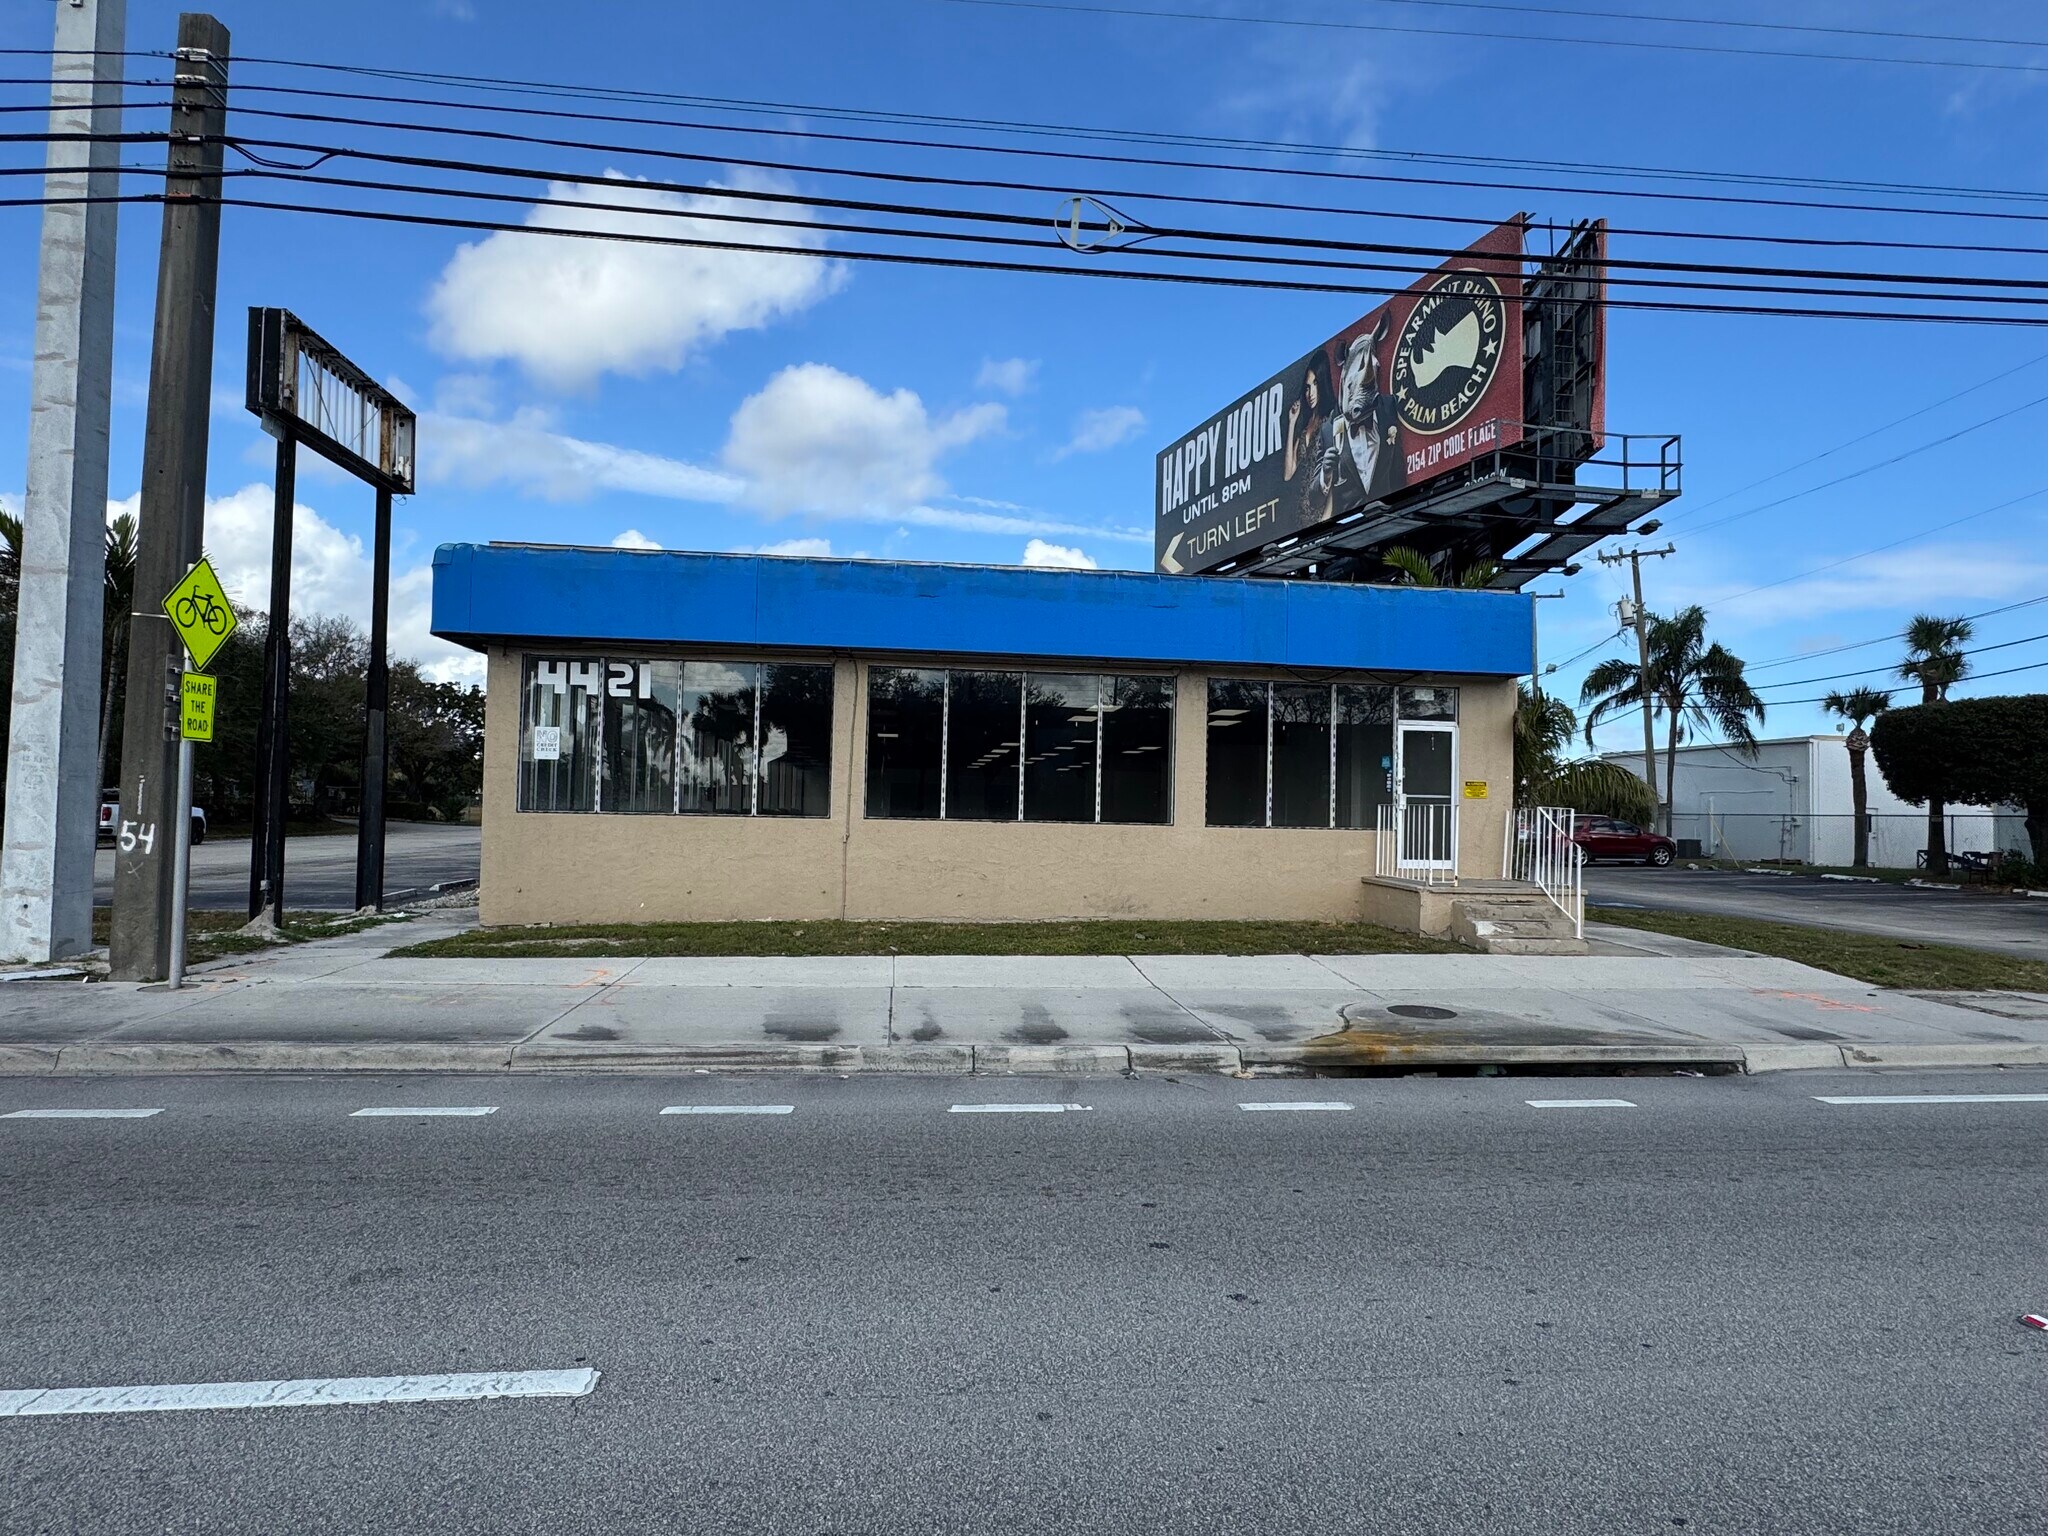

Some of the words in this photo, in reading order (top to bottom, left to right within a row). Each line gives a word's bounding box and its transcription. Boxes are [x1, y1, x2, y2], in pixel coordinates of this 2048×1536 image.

[1396, 281, 1460, 381] SPEARMINT
[1462, 280, 1497, 333] RHINO
[1404, 398, 1437, 423] PALM
[1440, 364, 1487, 420] BEACH
[1162, 421, 1222, 516] HAPPY
[1224, 382, 1283, 479] HOUR
[1406, 448, 1426, 475] 2154
[1427, 442, 1442, 466] ZIP
[1443, 430, 1466, 459] CODE
[1183, 492, 1219, 524] UNTIL
[1221, 475, 1251, 504] 8PM
[1187, 522, 1230, 559] TURN
[1235, 498, 1280, 538] LEFT
[185, 681, 212, 696] SHARE
[537, 660, 652, 699] 4421
[187, 718, 208, 732] ROAD
[191, 700, 206, 714] THE
[536, 730, 559, 743] NO
[120, 820, 155, 855] 54
